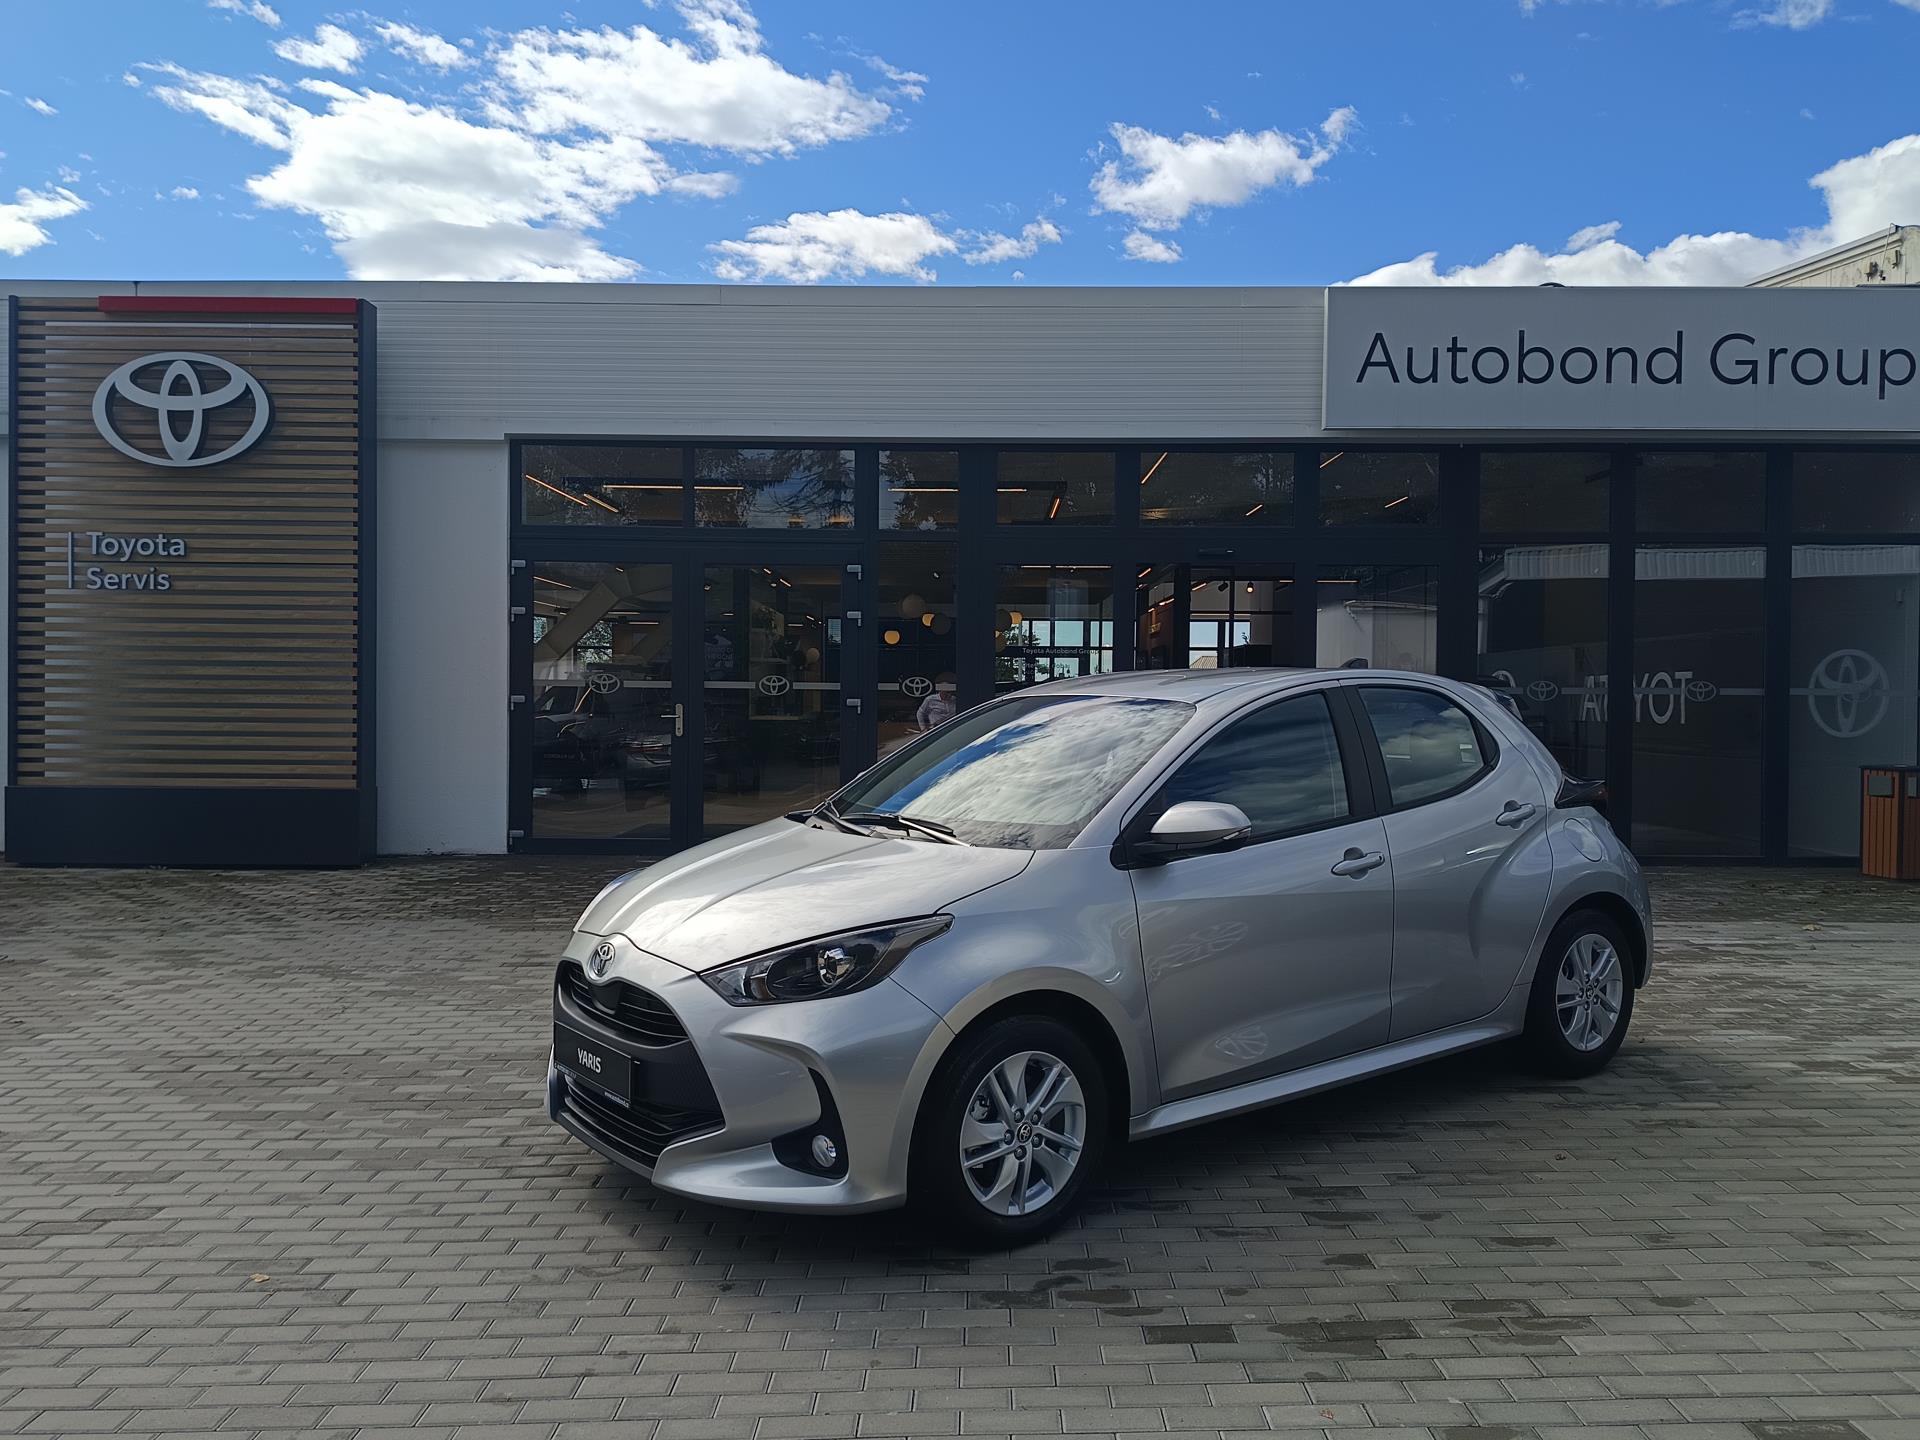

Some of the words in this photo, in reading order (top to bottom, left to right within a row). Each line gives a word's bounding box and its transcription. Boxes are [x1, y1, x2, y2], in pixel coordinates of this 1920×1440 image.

[1355, 329, 1683, 386] Autobond
[1709, 331, 1918, 400] Group
[86, 531, 186, 562] Toyota
[86, 567, 171, 590] Servis
[577, 1047, 602, 1074] YARIS
